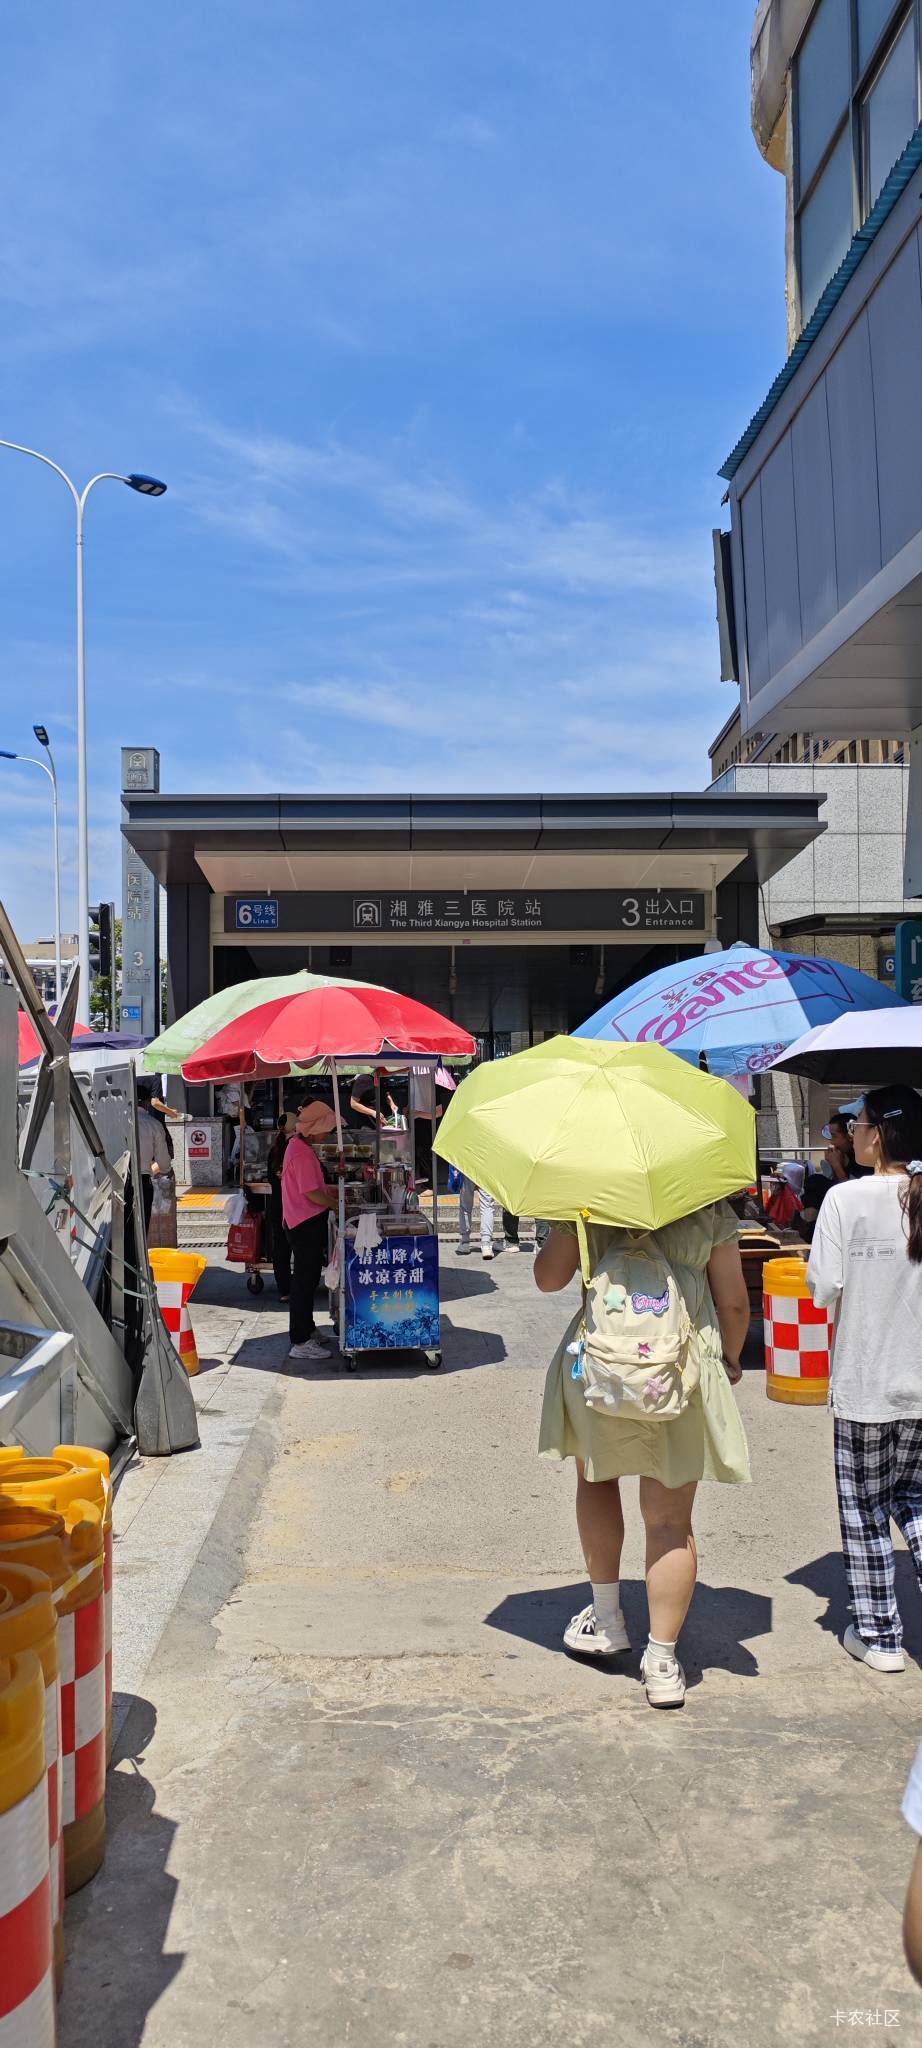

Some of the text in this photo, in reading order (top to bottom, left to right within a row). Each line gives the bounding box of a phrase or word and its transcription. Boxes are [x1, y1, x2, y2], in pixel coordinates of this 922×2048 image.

[390, 899, 542, 917] 湘雅三医院站
[621, 897, 694, 927] 3 出入口
[390, 918, 542, 929] The Third Xiangya Hospital Station
[645, 918, 694, 926] Entrance
[133, 951, 144, 967] 3
[358, 1267, 425, 1285] 冰凉香甜
